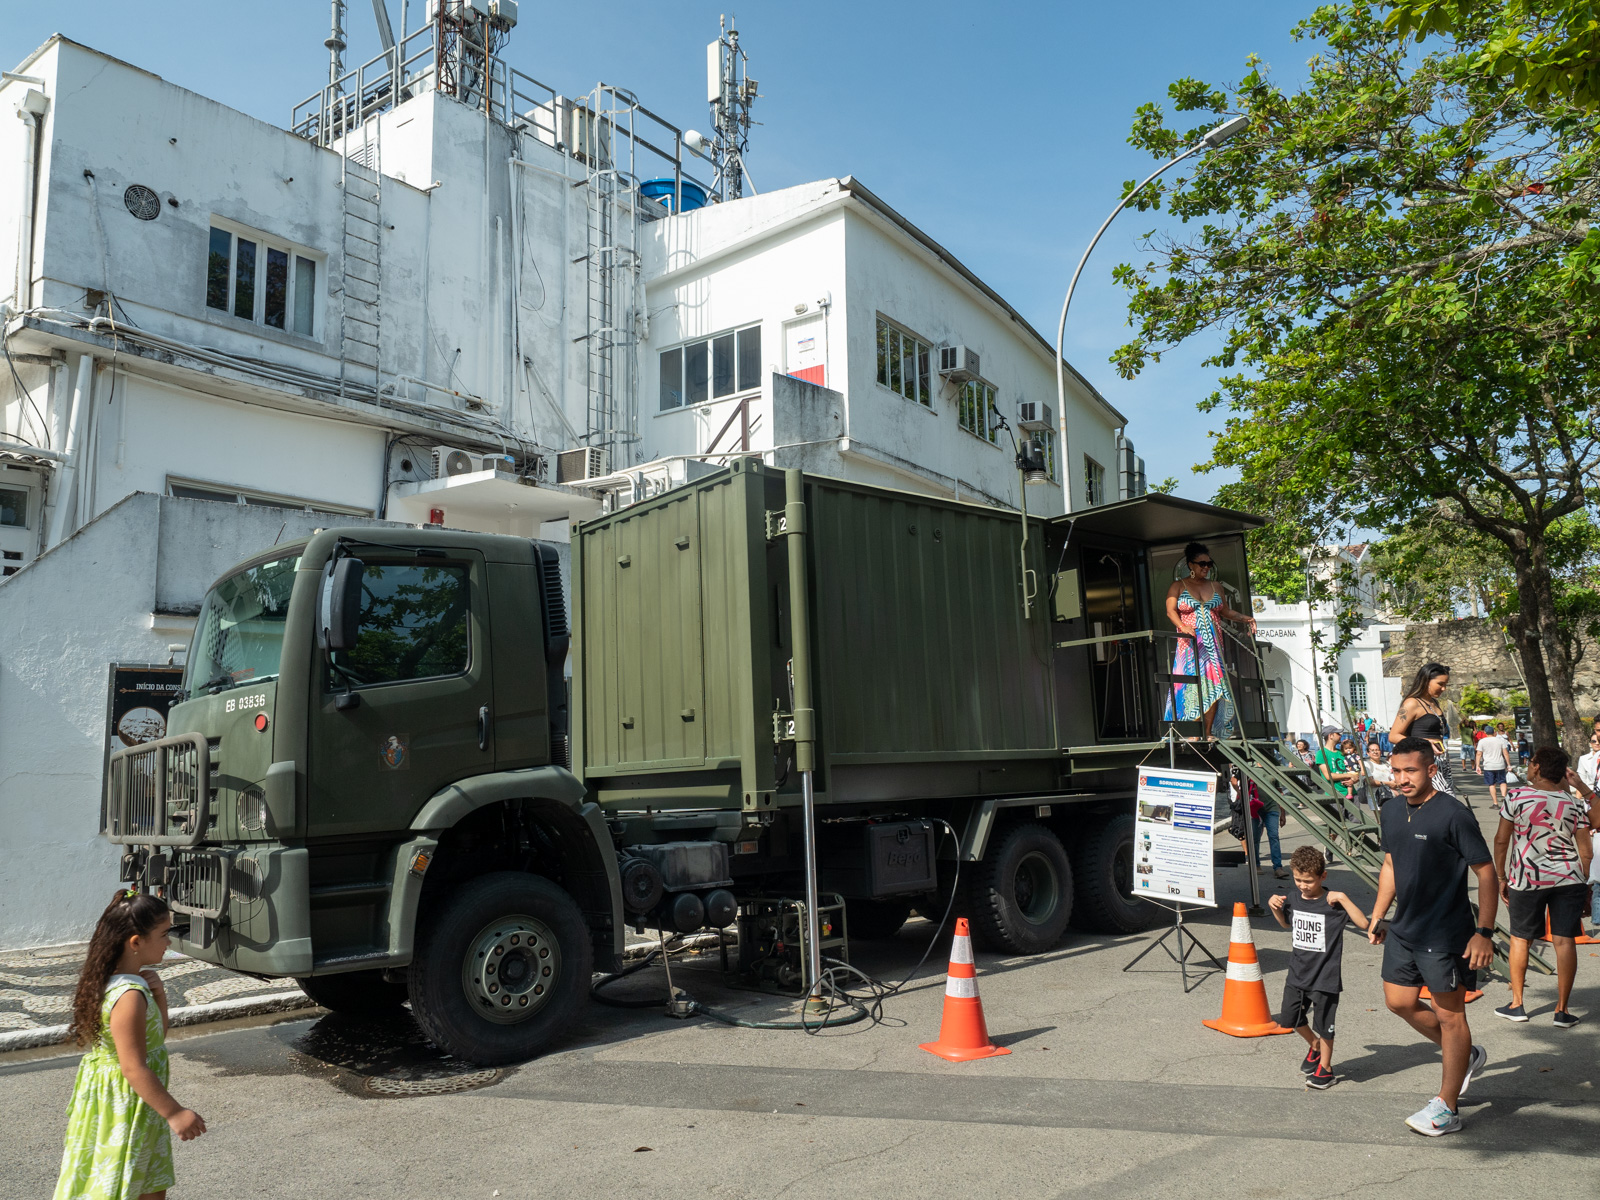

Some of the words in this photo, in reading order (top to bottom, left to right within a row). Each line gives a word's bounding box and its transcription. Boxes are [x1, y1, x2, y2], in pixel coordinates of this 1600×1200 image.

[780, 517, 787, 531] 2
[1256, 629, 1297, 638] OPACABANA
[136, 681, 155, 691] INÍCIO
[156, 683, 165, 691] DA
[225, 699, 236, 713] EB
[238, 694, 266, 710] 03836
[788, 720, 796, 735] 2
[1294, 918, 1322, 933] YOUNG
[1295, 930, 1318, 944] SURF
